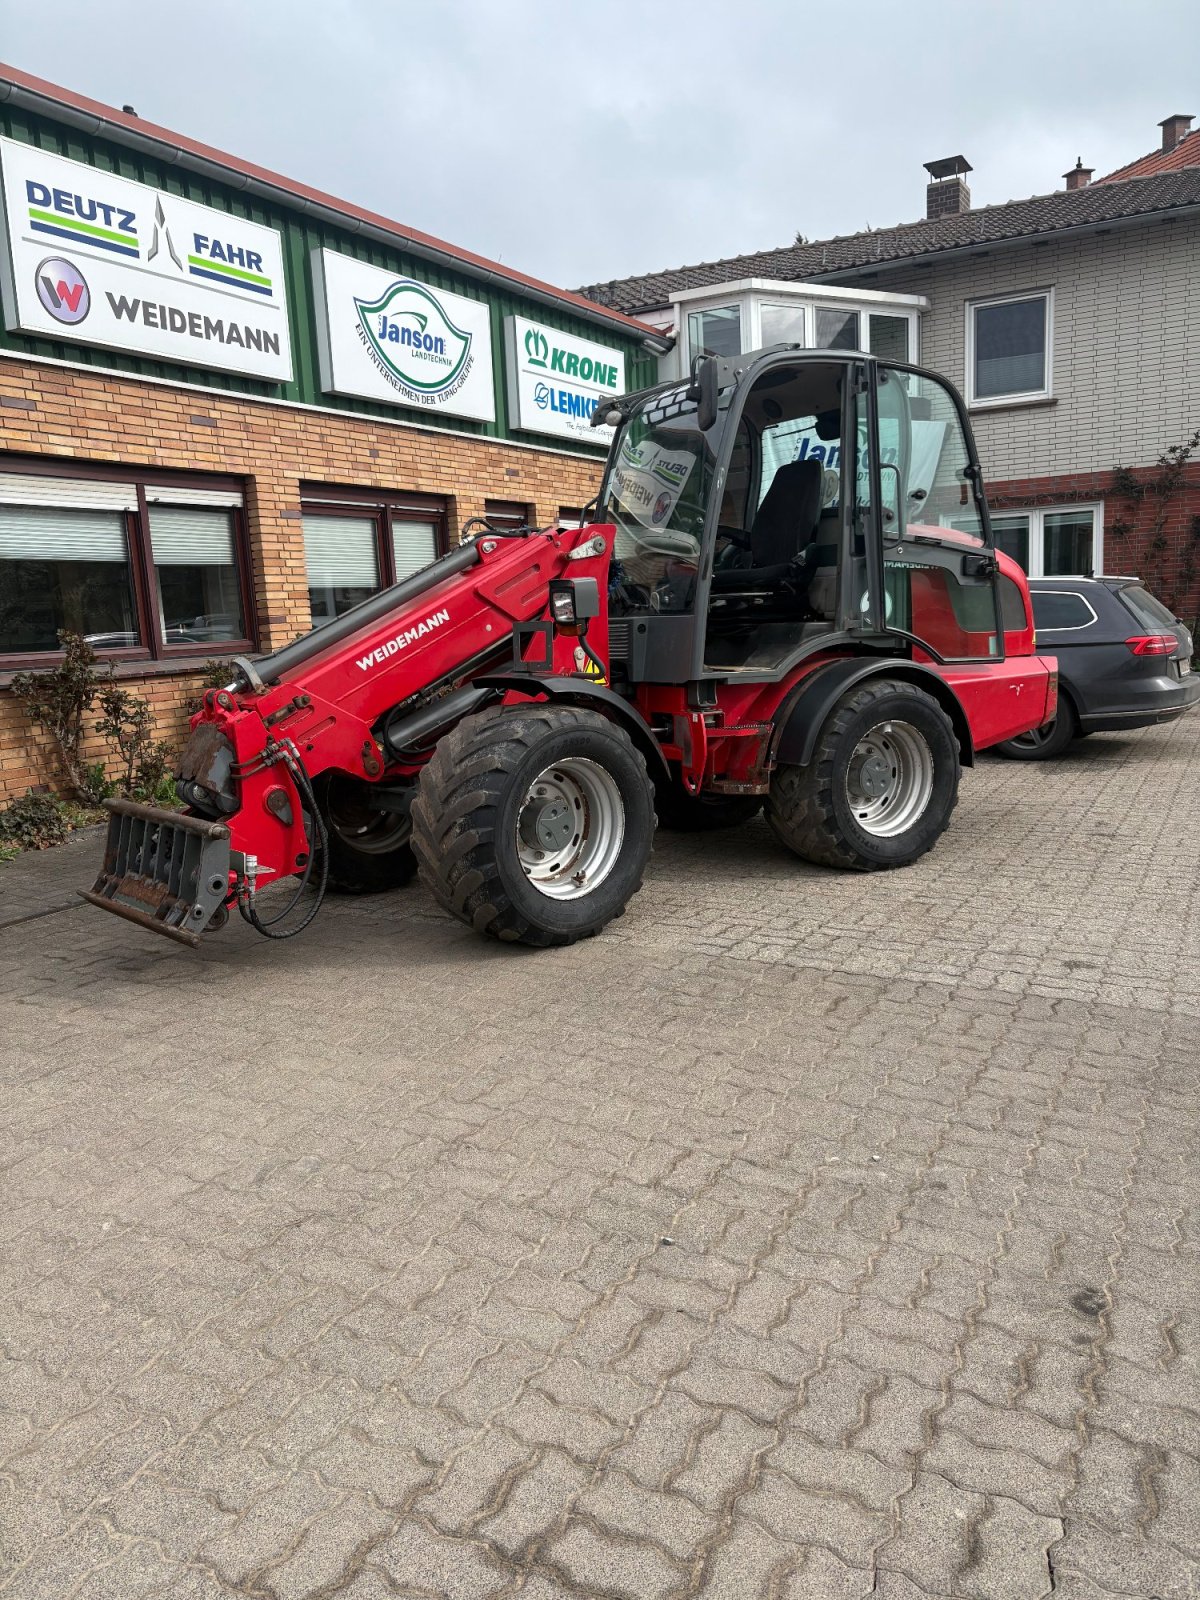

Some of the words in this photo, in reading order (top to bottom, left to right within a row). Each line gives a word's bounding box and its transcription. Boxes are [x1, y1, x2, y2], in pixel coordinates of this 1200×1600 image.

[26, 180, 137, 234] DEUTZ
[193, 232, 264, 273] FAHR
[105, 291, 280, 355] WEIDEMANN
[378, 315, 444, 355] Janson
[355, 323, 369, 346] EIN
[366, 346, 420, 403] UNTERNEHMEN
[421, 395, 436, 405] DER
[437, 354, 475, 403] TUPAG-GRUPPE
[411, 349, 453, 367] LANDTECHNIK
[551, 347, 618, 388] KRONE
[355, 608, 450, 671] WEIDEMANN
